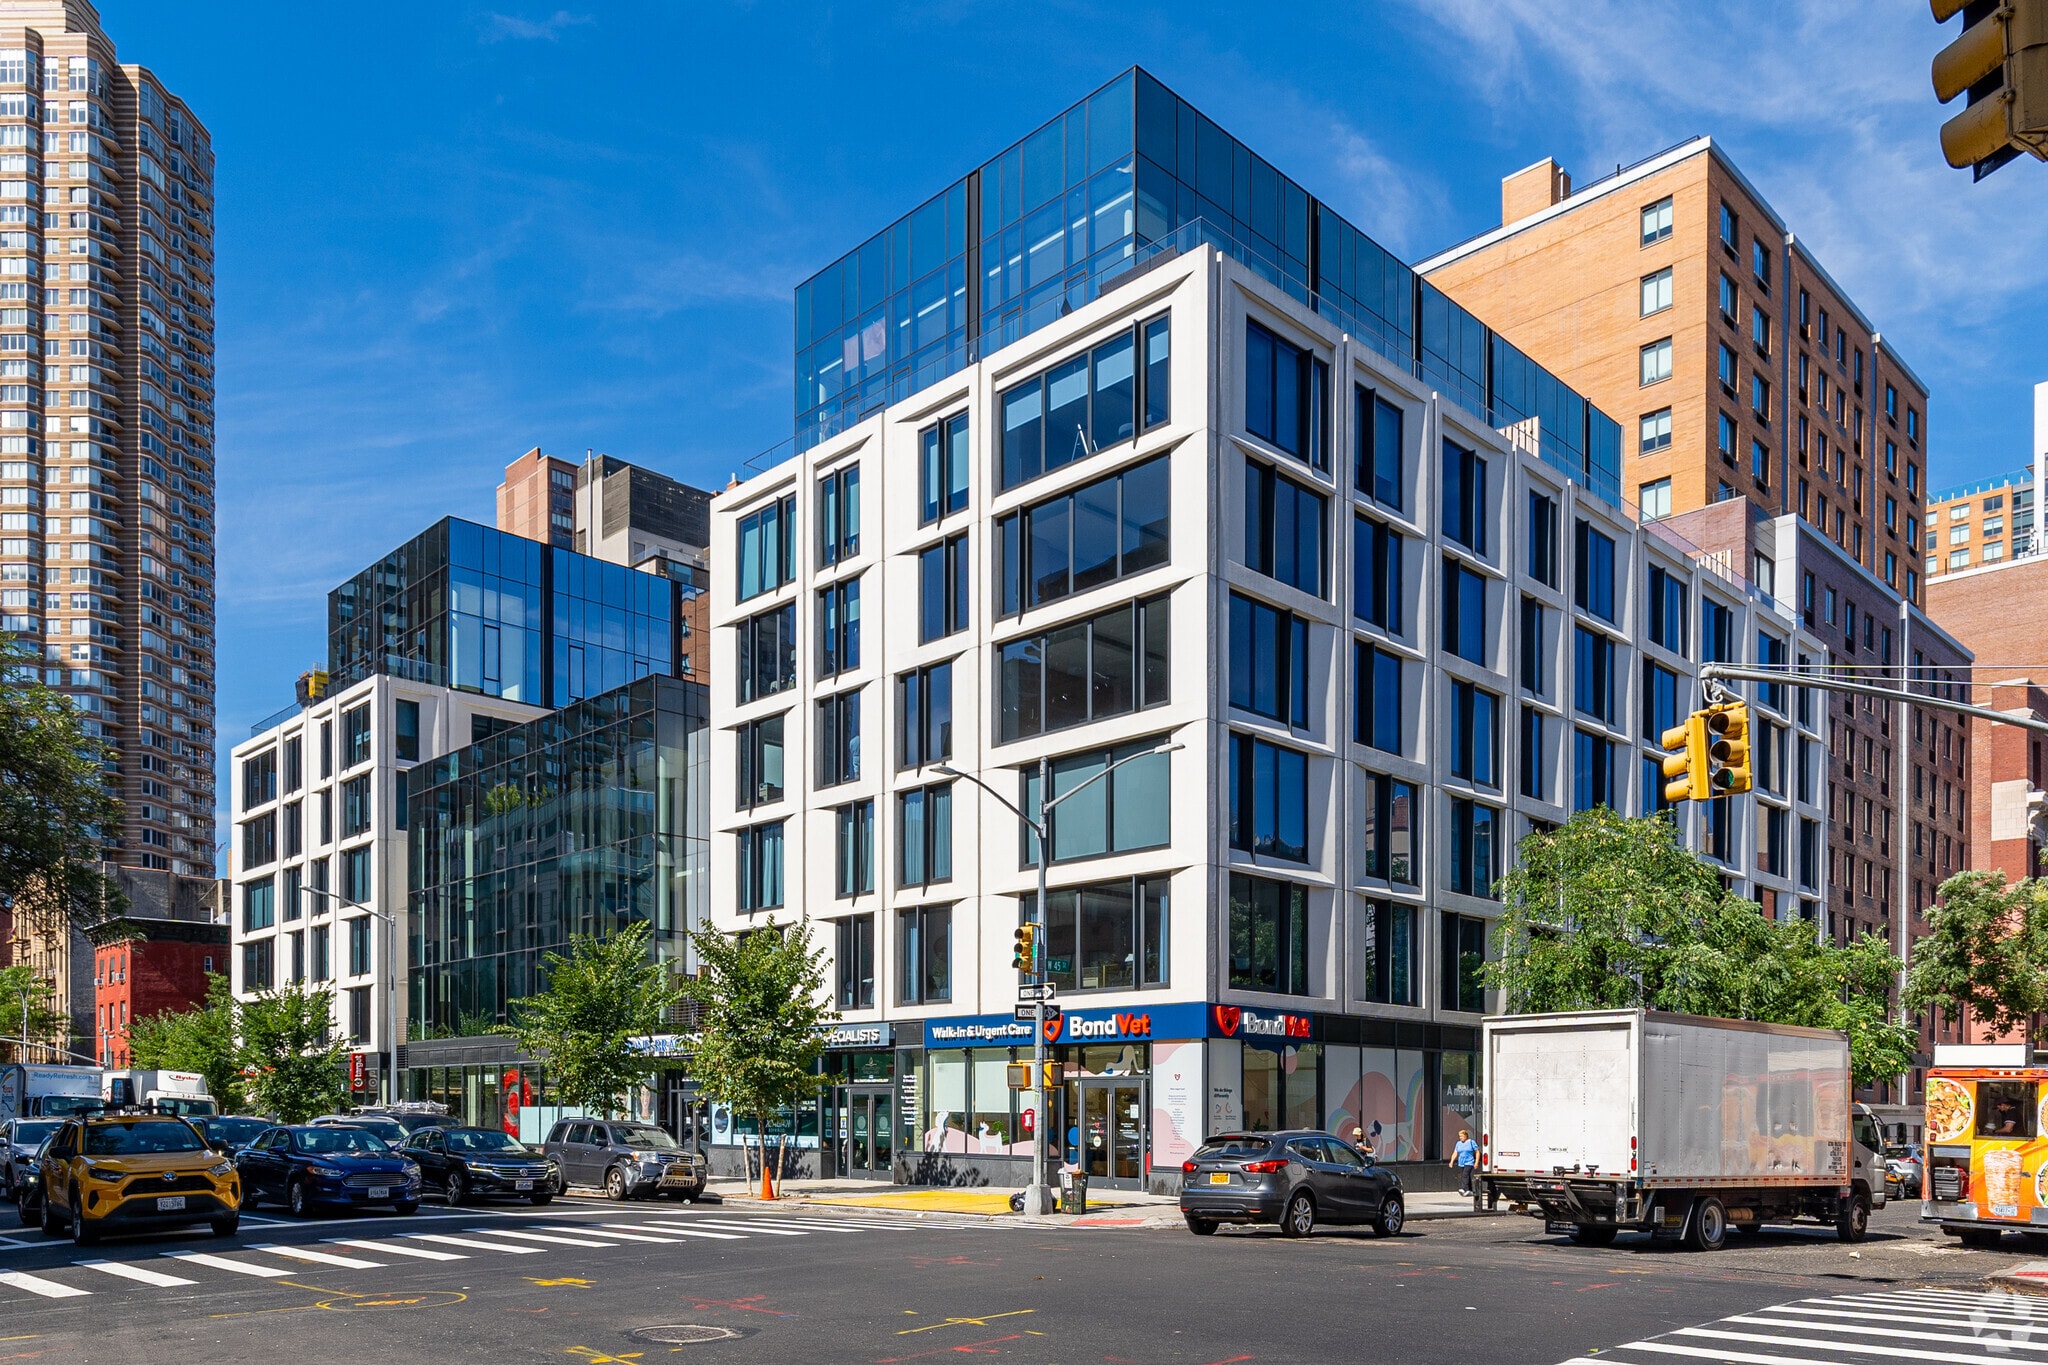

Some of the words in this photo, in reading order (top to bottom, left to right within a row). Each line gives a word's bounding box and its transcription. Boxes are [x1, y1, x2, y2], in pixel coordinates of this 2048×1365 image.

[1047, 961, 1053, 971] W
[1053, 961, 1061, 971] 45
[932, 1026, 965, 1039] Walk-In
[966, 1025, 974, 1037] &
[975, 1024, 1007, 1040] Urgent
[1007, 1023, 1033, 1035] Care
[354, 1054, 364, 1077] target
[33, 1071, 93, 1080] ReadyRefresh.com
[1446, 1084, 1453, 1096] A
[1446, 1103, 1460, 1115] you
[1460, 1101, 1473, 1112] and
